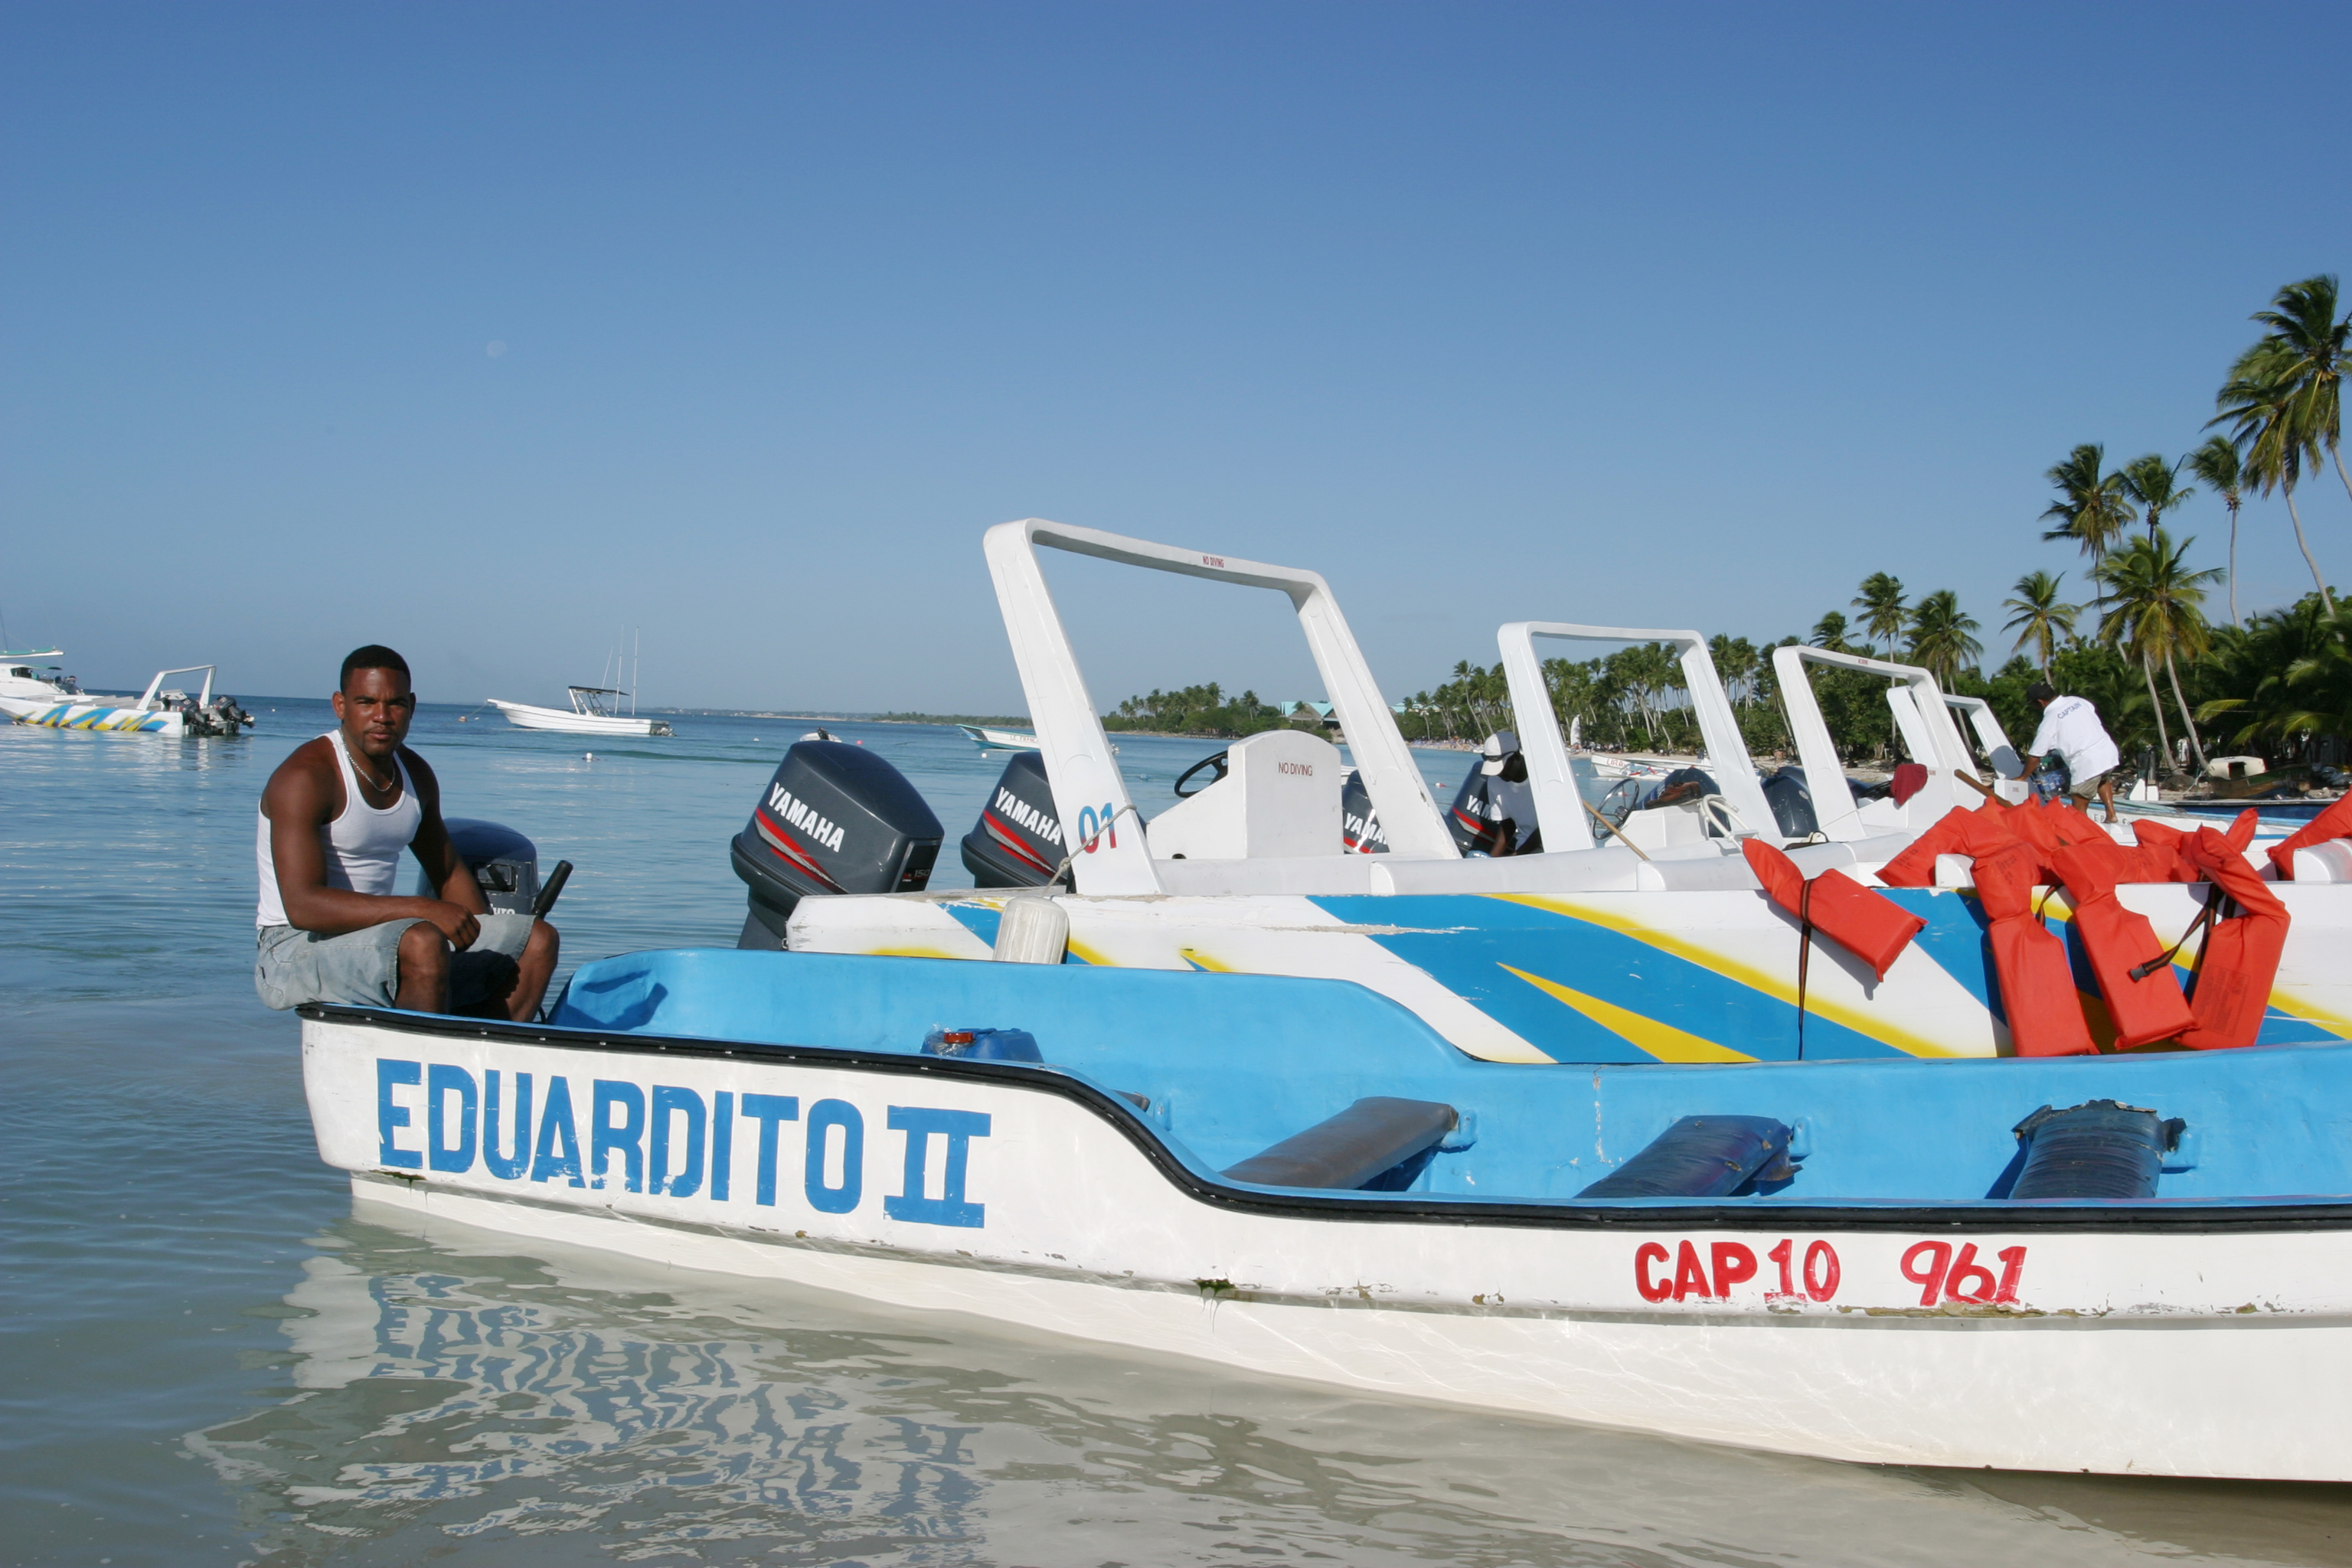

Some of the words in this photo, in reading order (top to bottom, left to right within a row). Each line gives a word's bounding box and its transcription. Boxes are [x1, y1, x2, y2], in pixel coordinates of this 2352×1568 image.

[2057, 701, 2082, 719] CAPTAIN
[1279, 762, 1289, 774] NO
[1290, 763, 1312, 776] DIVING
[769, 782, 844, 852] YAMAHA
[995, 786, 1062, 845] YAMAHA
[1078, 802, 1117, 854] 01
[1344, 812, 1387, 844] YAMA
[1466, 795, 1491, 820] YAM
[377, 1057, 864, 1214] EDUARDITO
[883, 1105, 991, 1229] II
[1635, 1240, 1757, 1302] CAP
[1763, 1239, 1841, 1302] 10
[1900, 1240, 2027, 1306] 961
